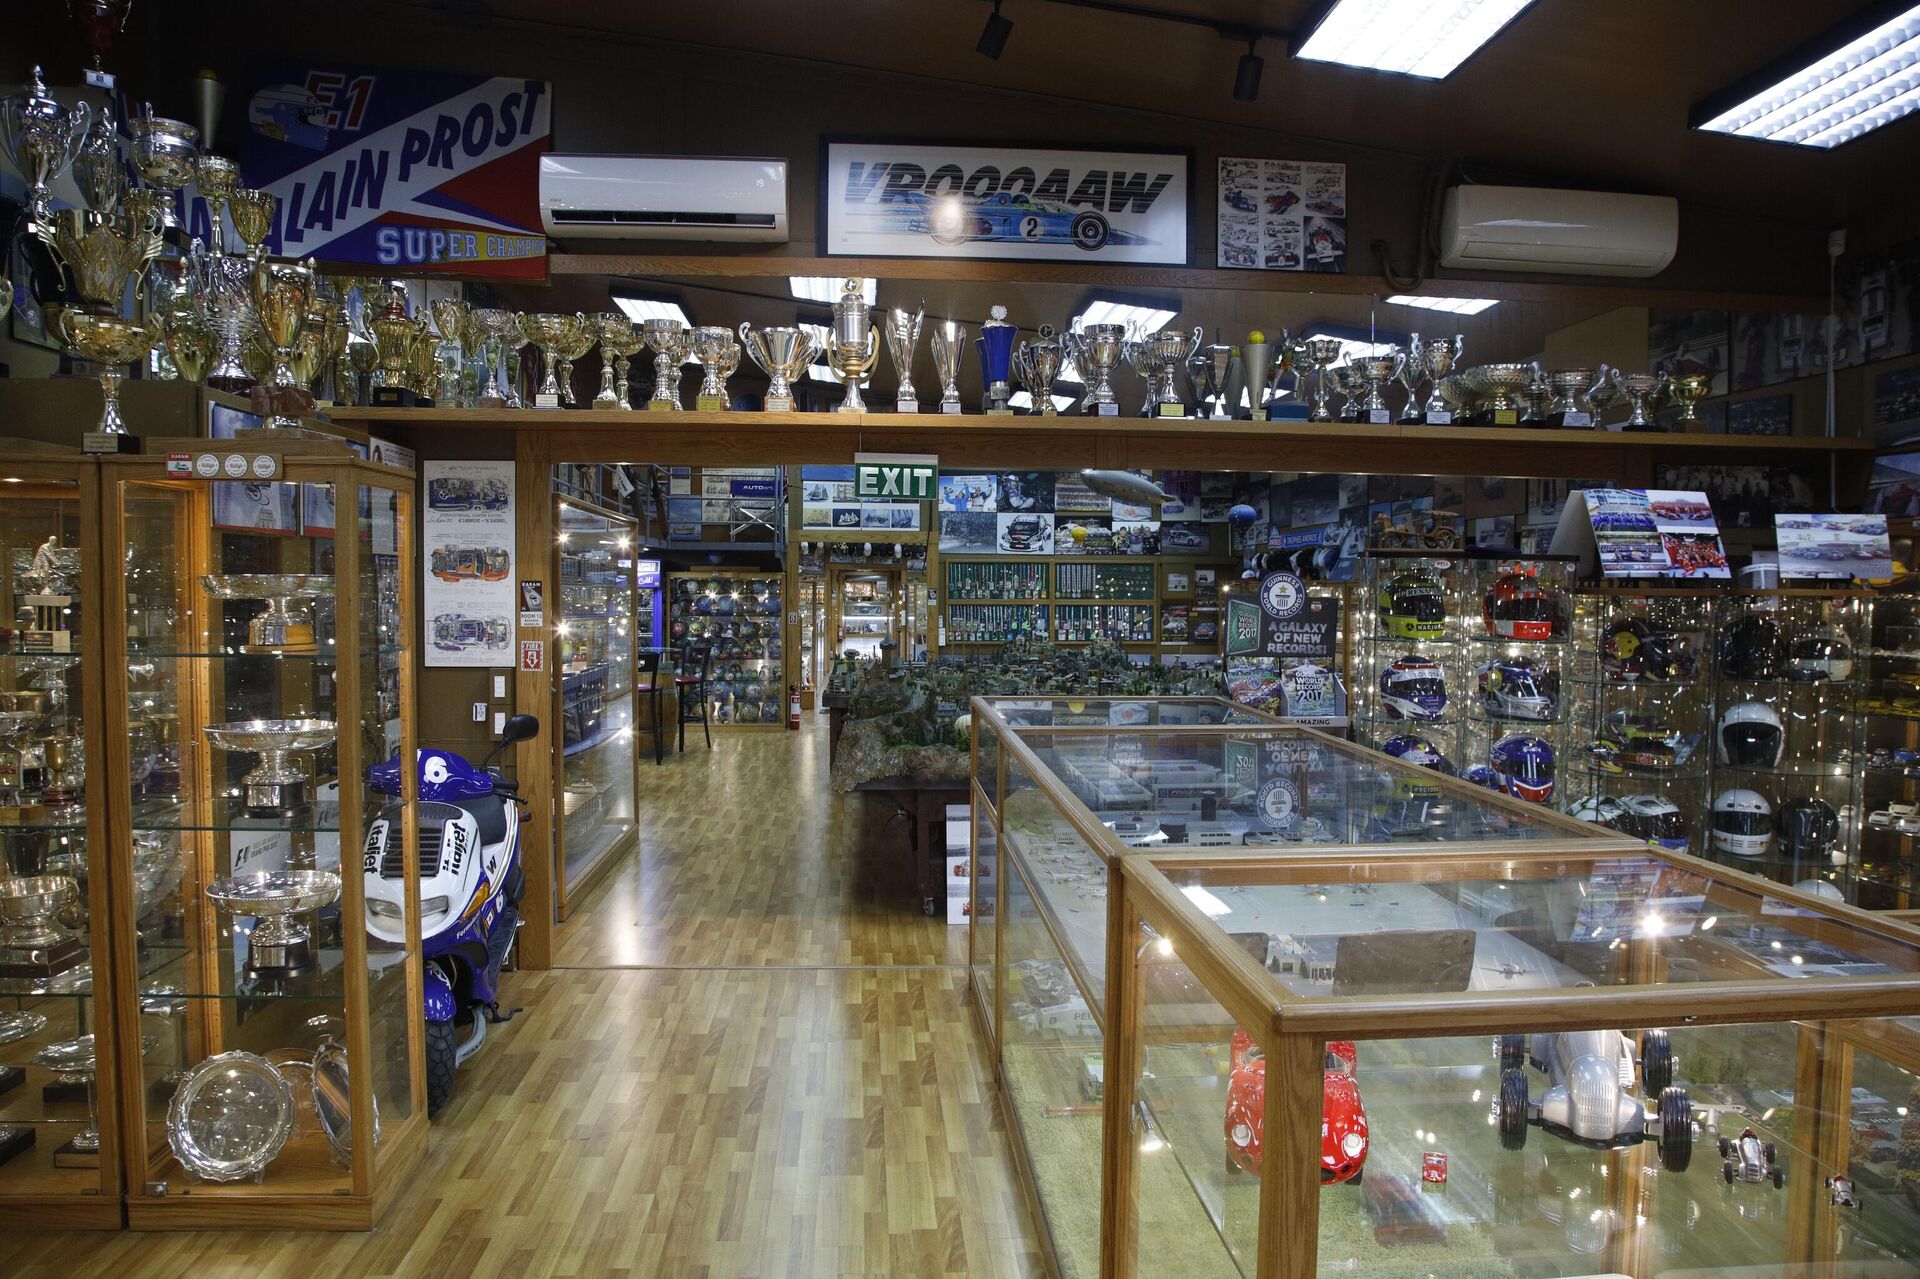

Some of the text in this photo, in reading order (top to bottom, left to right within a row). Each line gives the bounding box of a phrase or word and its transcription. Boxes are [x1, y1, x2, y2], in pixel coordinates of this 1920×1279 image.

[399, 80, 547, 182] PROST
[843, 160, 1175, 214] VROOOAAW
[1026, 217, 1039, 238] 2
[376, 225, 547, 266] SUPER CHAMPION
[859, 466, 933, 497] EXIT
[1267, 574, 1300, 589] GUINNESS
[1262, 593, 1303, 617] WORLD RECORDS
[1239, 627, 1257, 641] 2017
[1268, 620, 1328, 634] A GALAXY
[1274, 632, 1322, 643] OF NEW
[1267, 641, 1327, 655] RECORDS!
[1297, 690, 1323, 703] 2017
[364, 823, 385, 874] italjet
[443, 822, 467, 877] italjet
